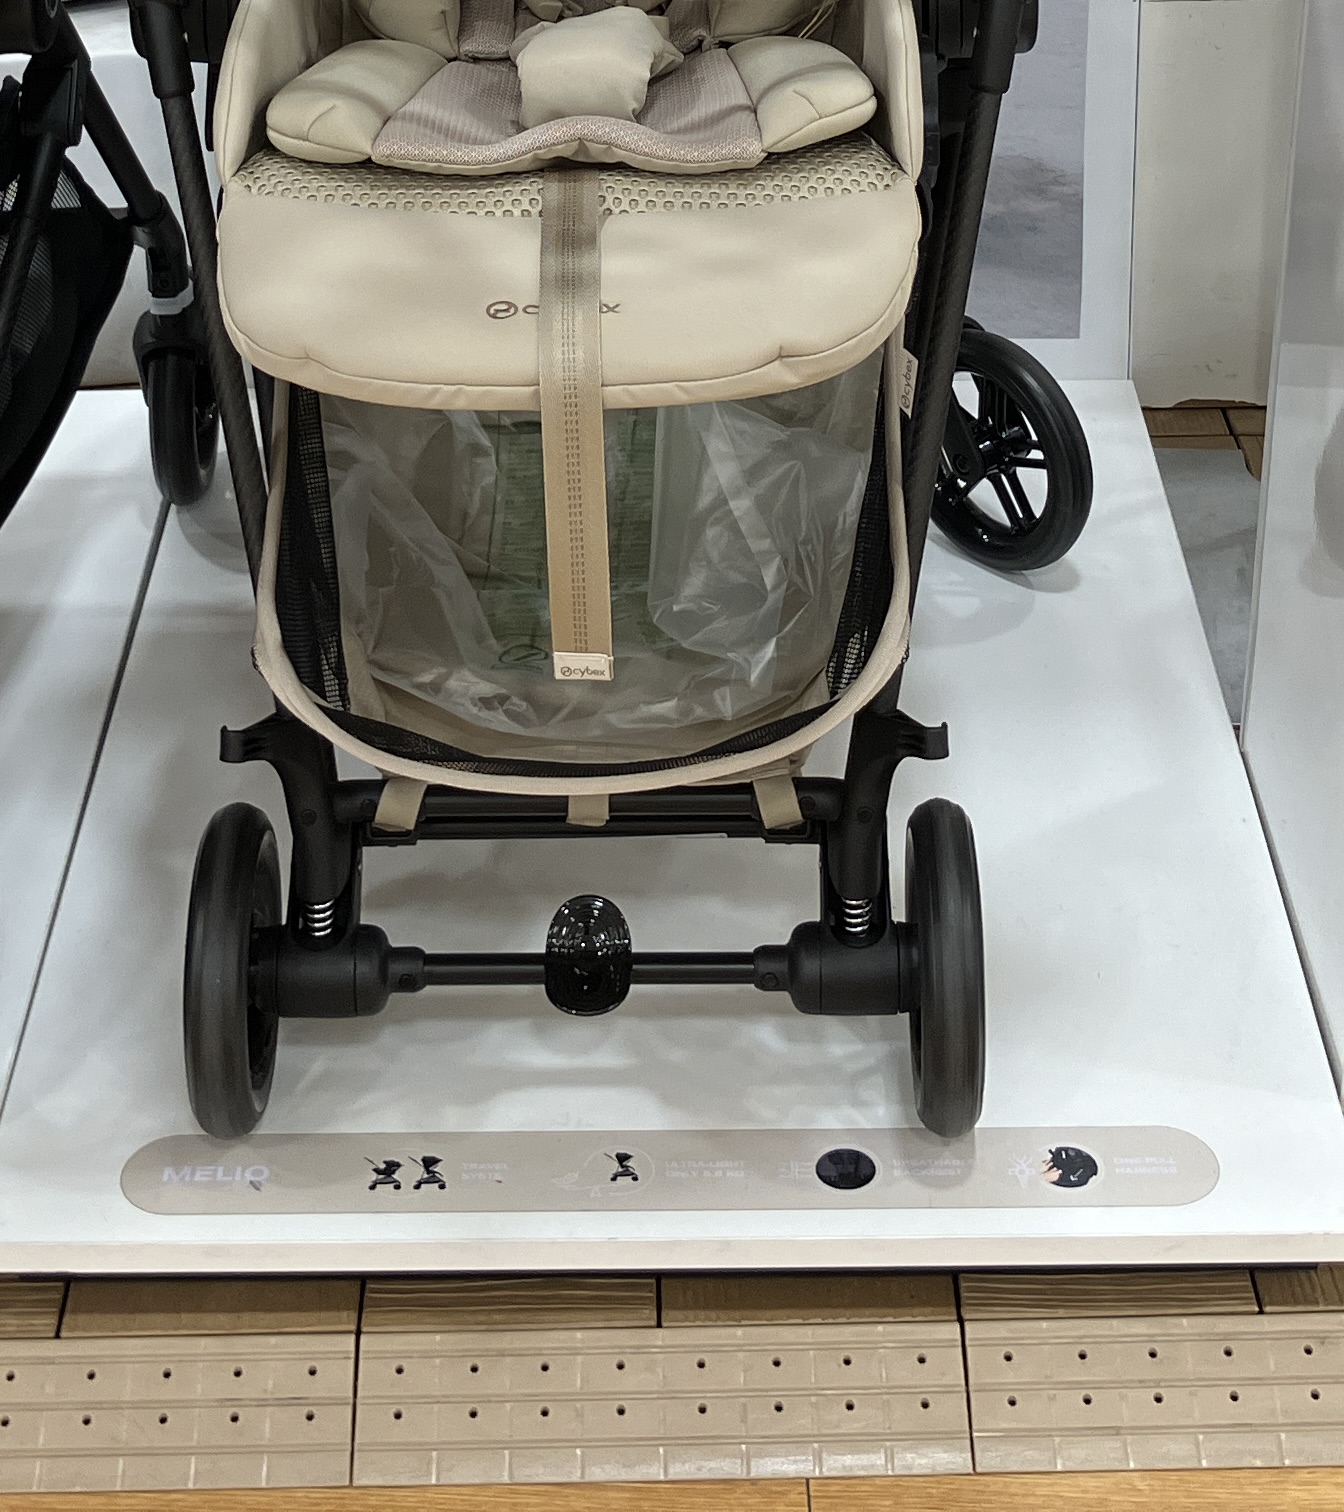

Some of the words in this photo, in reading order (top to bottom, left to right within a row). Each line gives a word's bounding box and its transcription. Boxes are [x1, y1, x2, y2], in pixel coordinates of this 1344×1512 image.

[901, 356, 914, 398] cybex
[573, 665, 607, 679] cybex
[162, 1164, 270, 1183] MELIO
